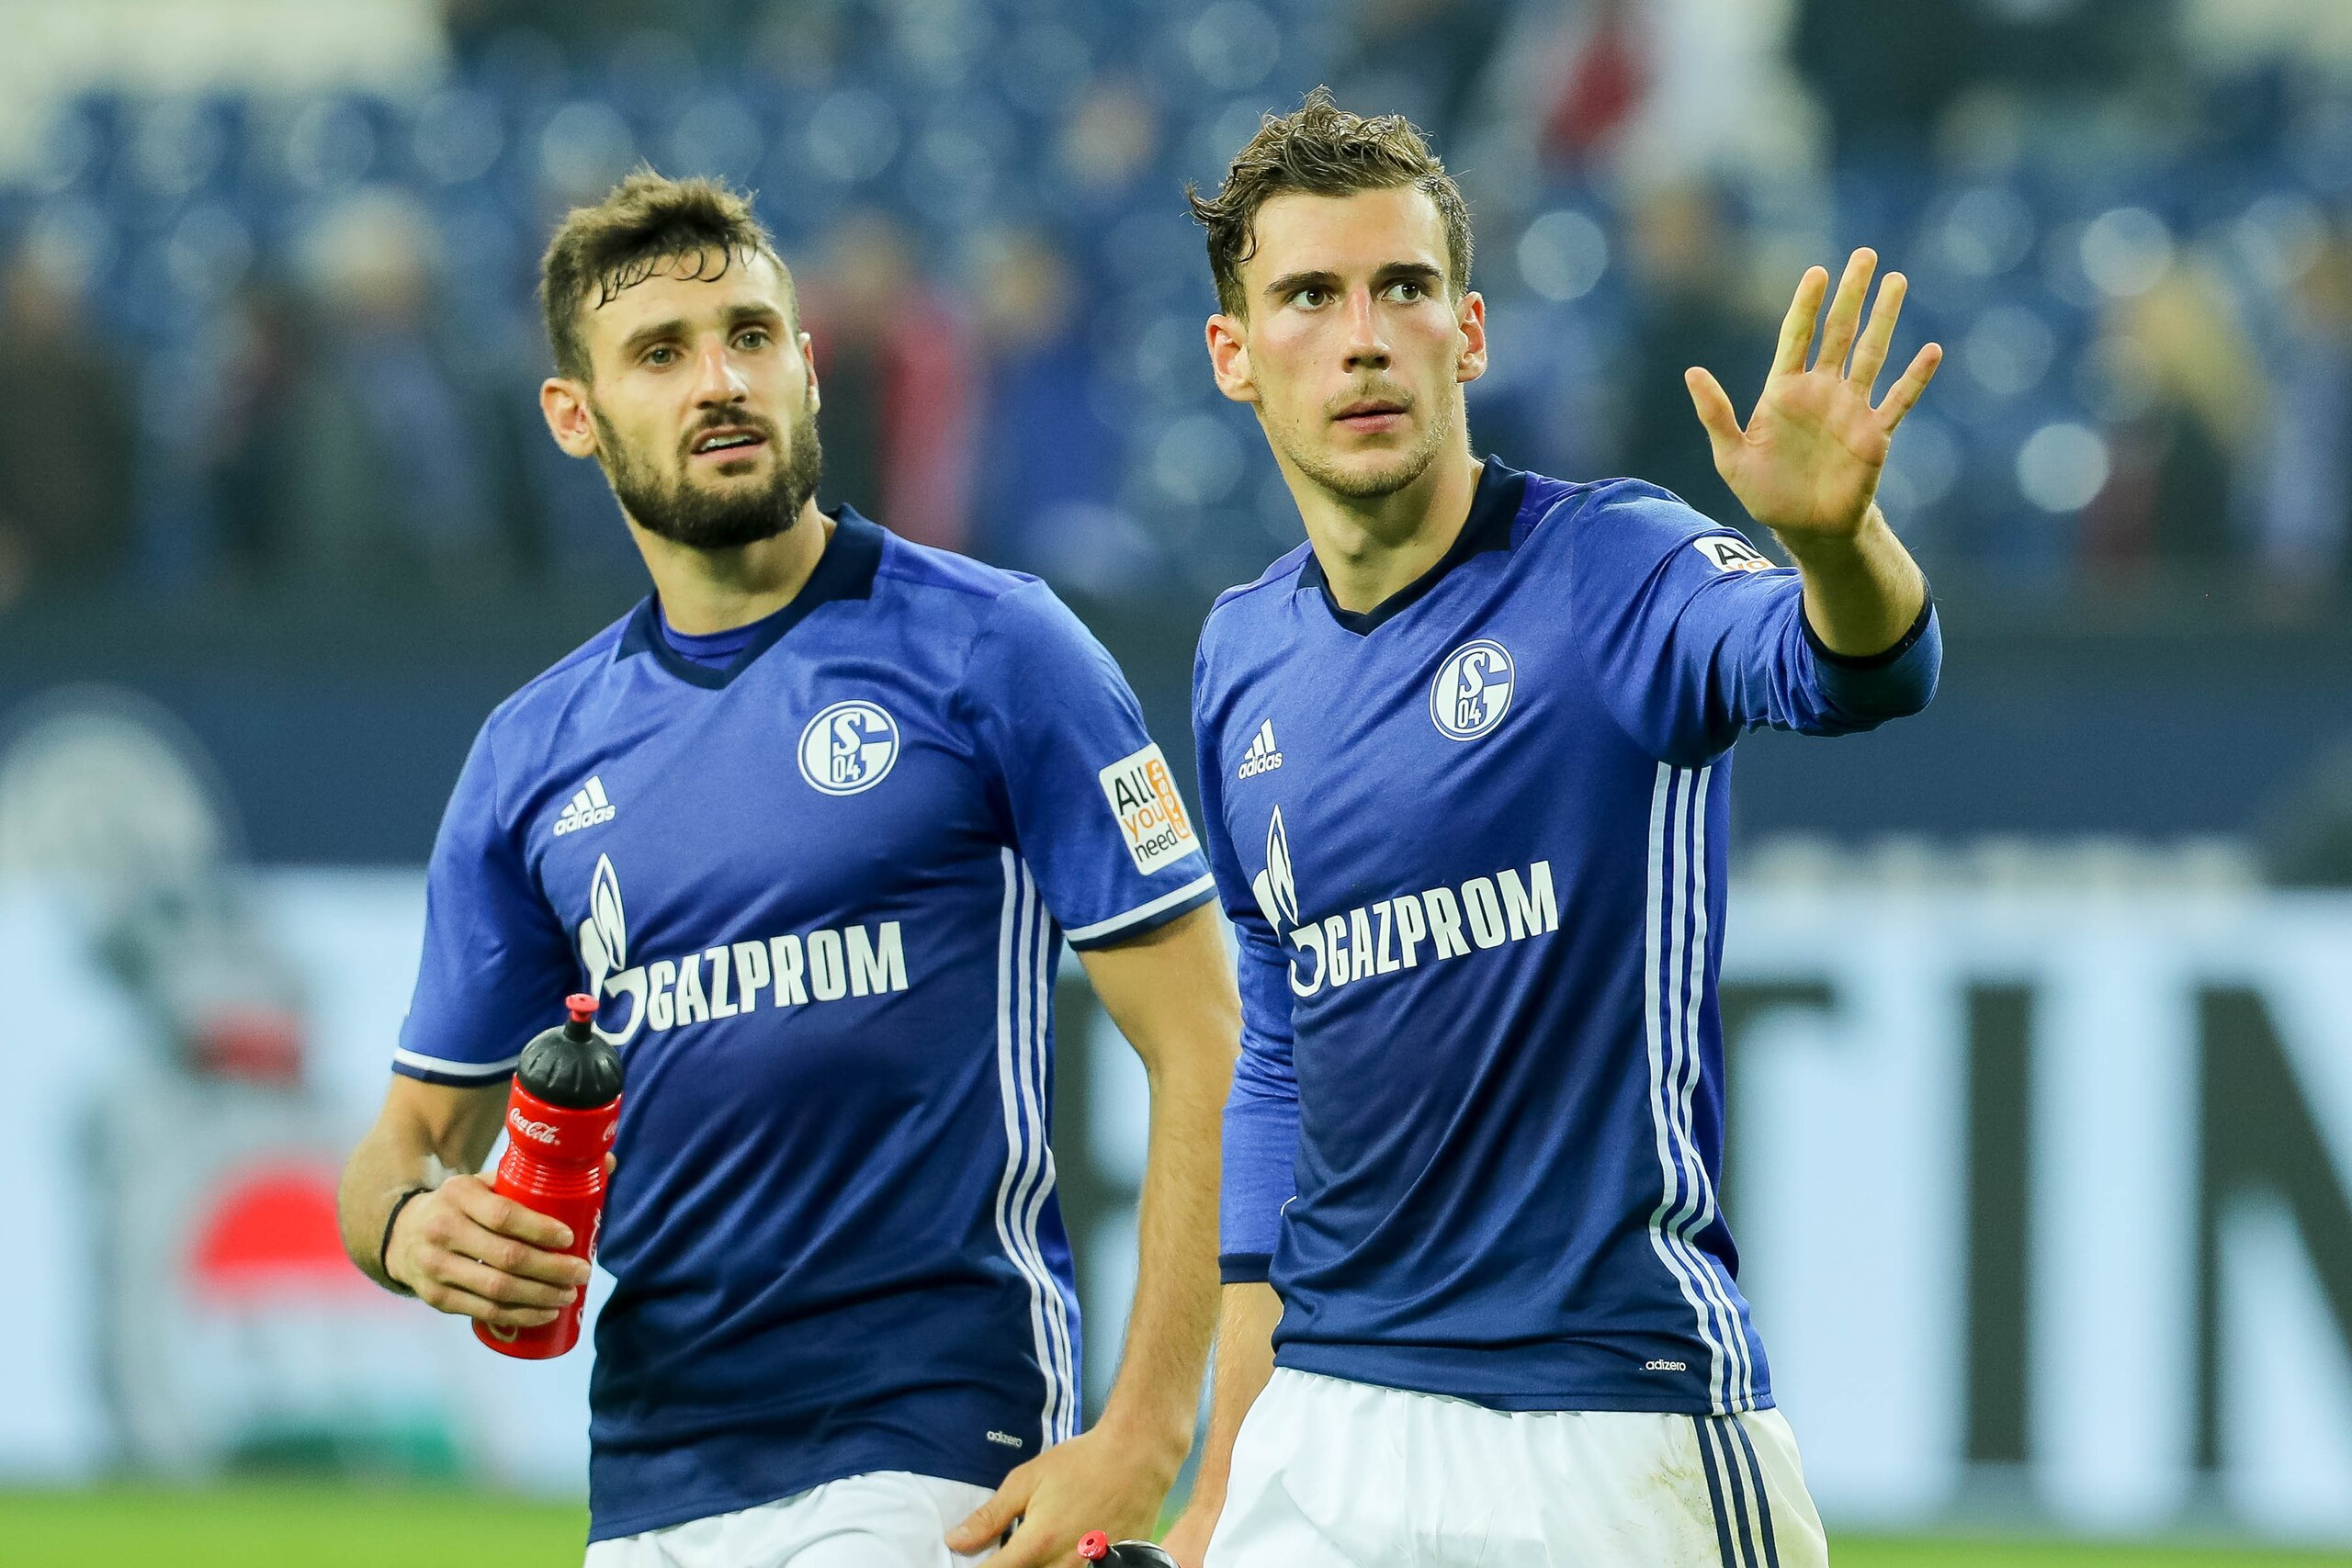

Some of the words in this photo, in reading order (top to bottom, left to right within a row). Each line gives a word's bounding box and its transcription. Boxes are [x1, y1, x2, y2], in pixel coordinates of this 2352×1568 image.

[1714, 543, 1763, 566] Al
[1457, 696, 1482, 728] 04
[831, 753, 862, 783] 04
[1238, 751, 1283, 780] adidas
[1114, 766, 1156, 816] All
[552, 804, 616, 838] adidas
[1124, 801, 1166, 842] you
[1134, 823, 1179, 863] need
[1325, 860, 1560, 988] GAZPROM
[646, 920, 910, 1032] GAZPROM
[1645, 1359, 1687, 1371] adizero
[986, 1430, 1023, 1448] adizero
